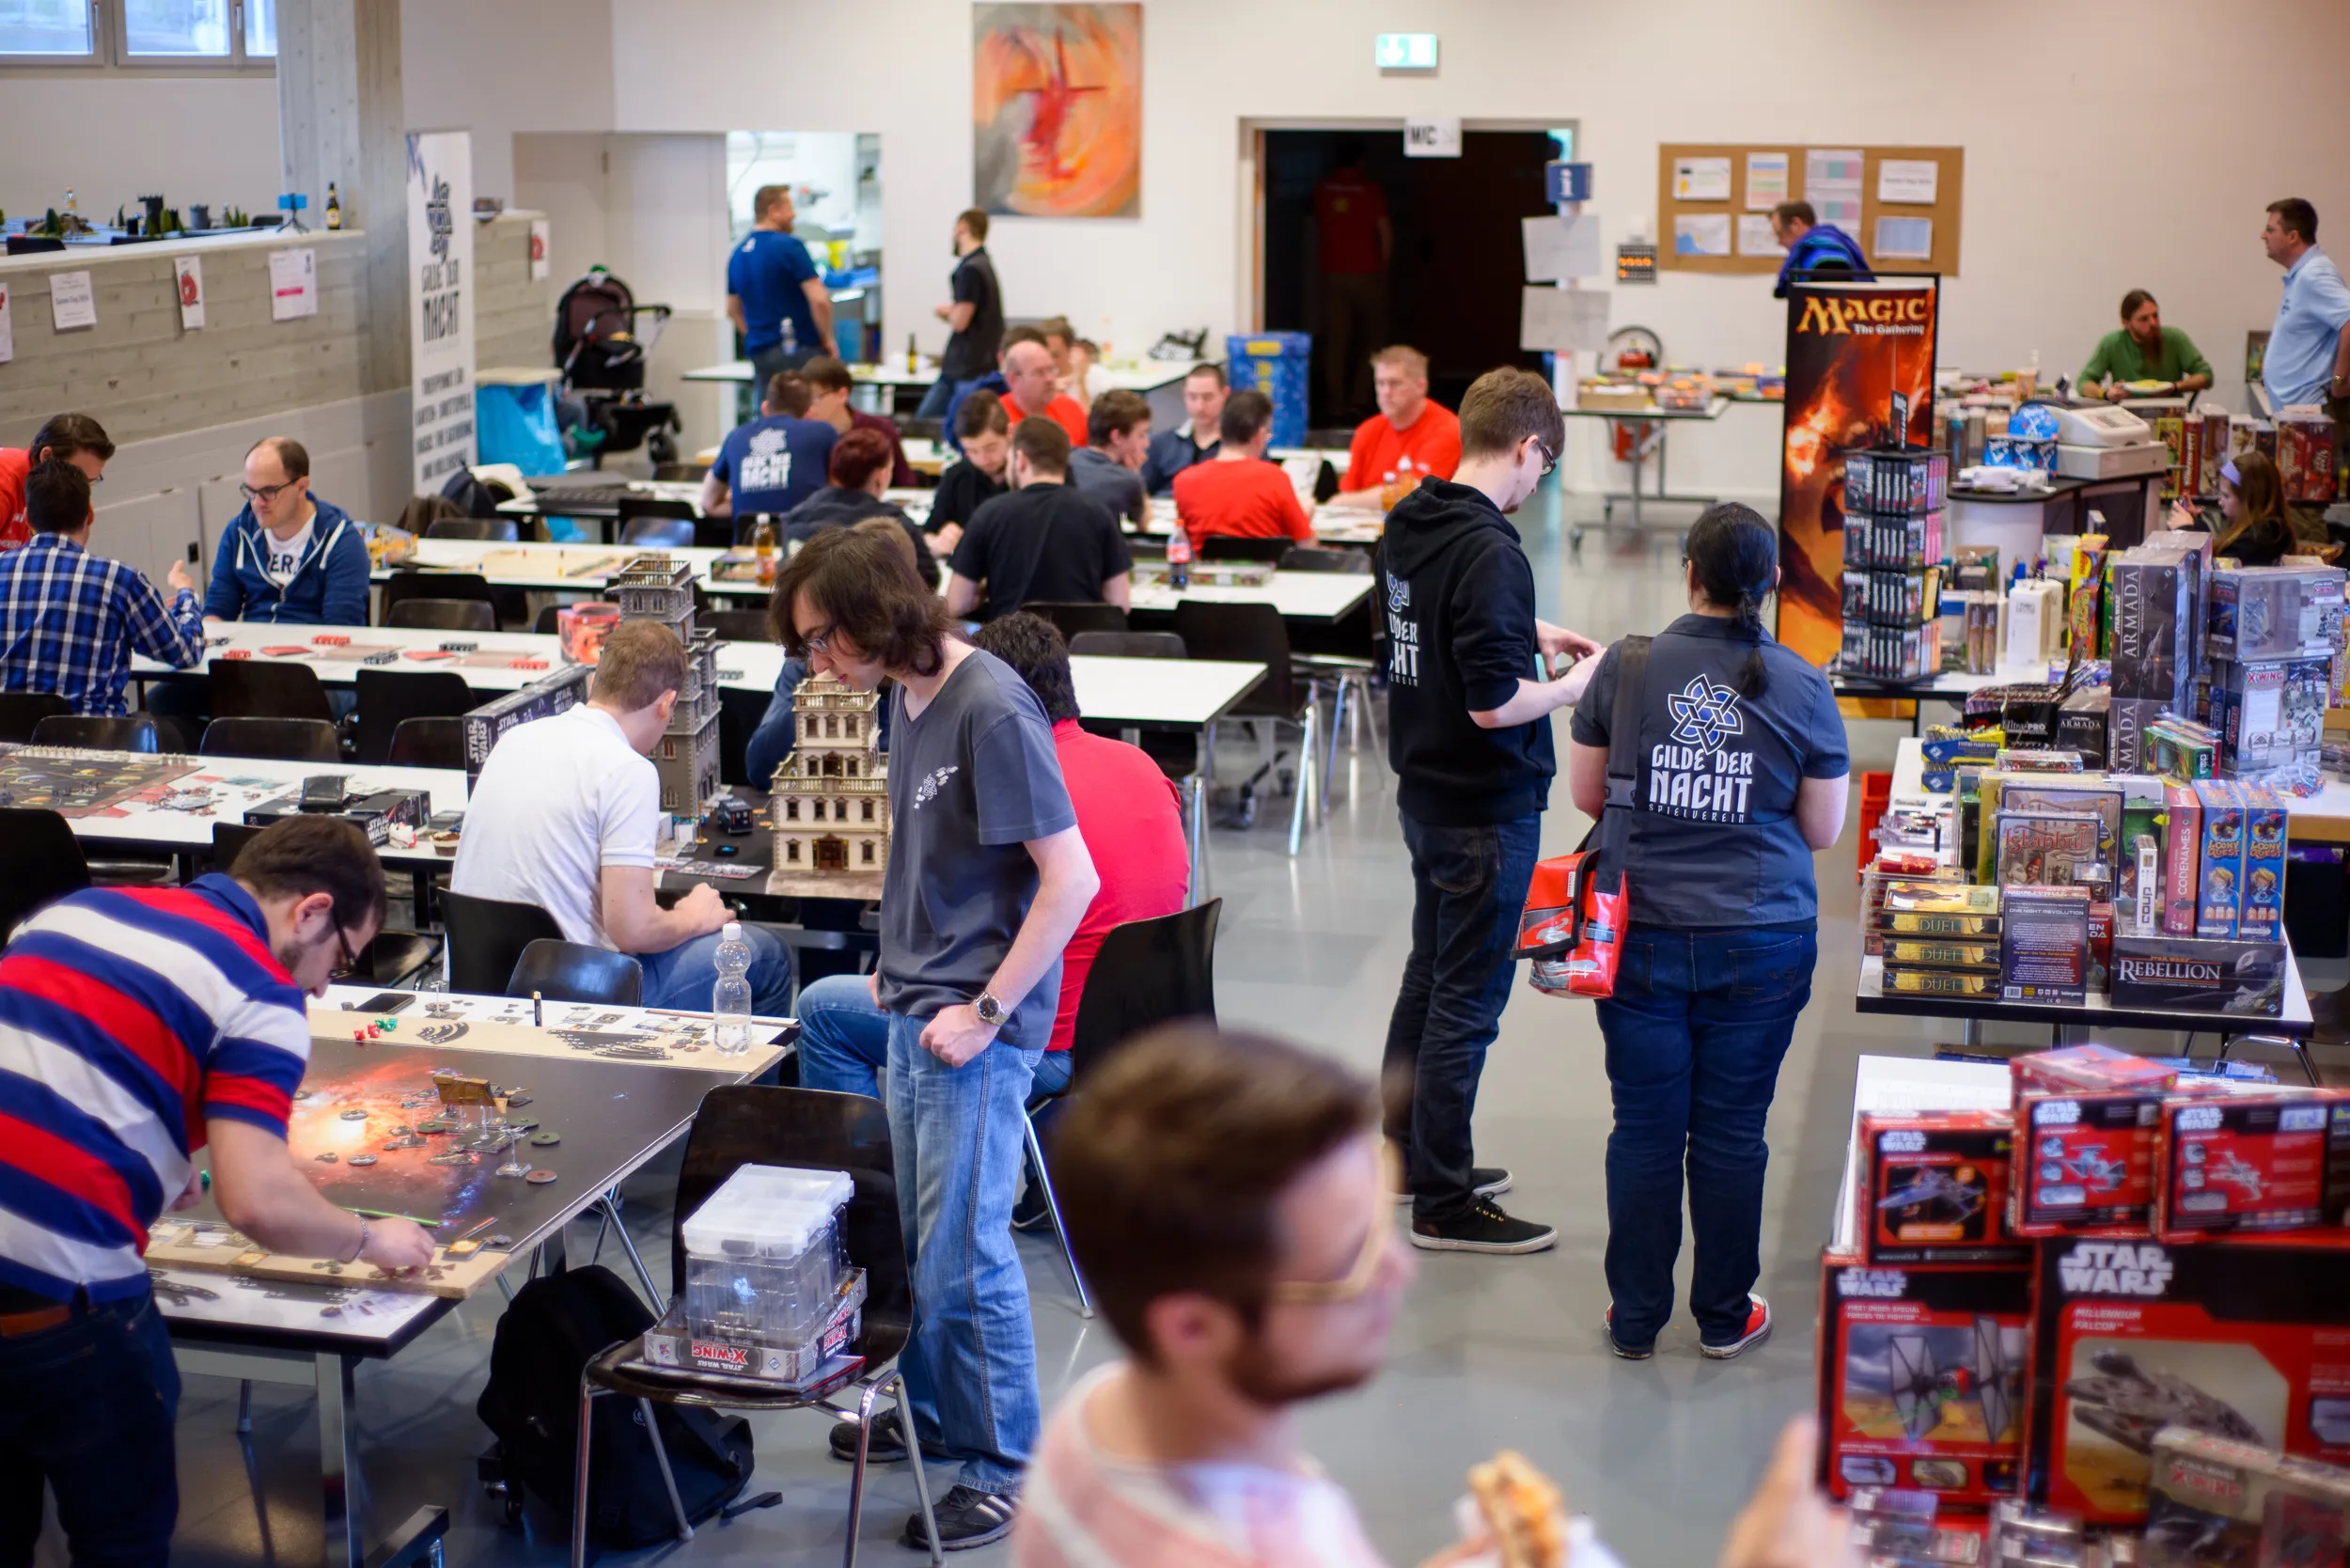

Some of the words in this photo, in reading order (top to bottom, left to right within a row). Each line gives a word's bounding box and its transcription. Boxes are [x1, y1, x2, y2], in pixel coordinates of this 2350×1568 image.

[422, 290, 460, 342] NACHT
[1796, 296, 1927, 337] MAGIC
[1853, 323, 1873, 336] The
[1875, 323, 1925, 336] Gathering
[2123, 571, 2138, 658] ARMADA
[2248, 670, 2284, 683] X-WING
[554, 687, 573, 705] STAR
[497, 712, 519, 731] STAR
[2060, 720, 2101, 729] ARMADA
[467, 720, 480, 763] STAR
[478, 720, 489, 763] WARS
[2119, 705, 2135, 775] RMADA
[1652, 744, 1705, 771] GILDE
[1716, 749, 1753, 776] DER
[1649, 769, 1752, 813] NACHT
[368, 814, 389, 831] STAR
[1649, 804, 1745, 823] SPIELVEREIN
[368, 824, 389, 842] WARS
[2005, 827, 2085, 854] Istanbul
[2207, 848, 2239, 859] QUEST
[2208, 840, 2239, 850] LOONY
[2249, 840, 2281, 850] LOONY
[2178, 828, 2191, 895] CODENAMES
[2249, 849, 2282, 860] QUEST
[1919, 919, 1960, 933] DUEL
[1921, 949, 1961, 962] DUEL
[2119, 960, 2221, 981] REBELLION
[1921, 979, 1961, 992] DUEL
[1881, 1140, 1927, 1152] WARS
[2060, 1244, 2173, 1269] STAR
[1837, 1266, 1907, 1281] STAR
[2060, 1267, 2173, 1295] WARS
[1838, 1279, 1907, 1297] WARS
[2075, 1308, 2141, 1319] MILLENNIUM
[691, 1345, 749, 1365] X-WING
[697, 1359, 721, 1370] WARS
[725, 1363, 744, 1372] STAR
[2170, 1466, 2242, 1498] X-WING
